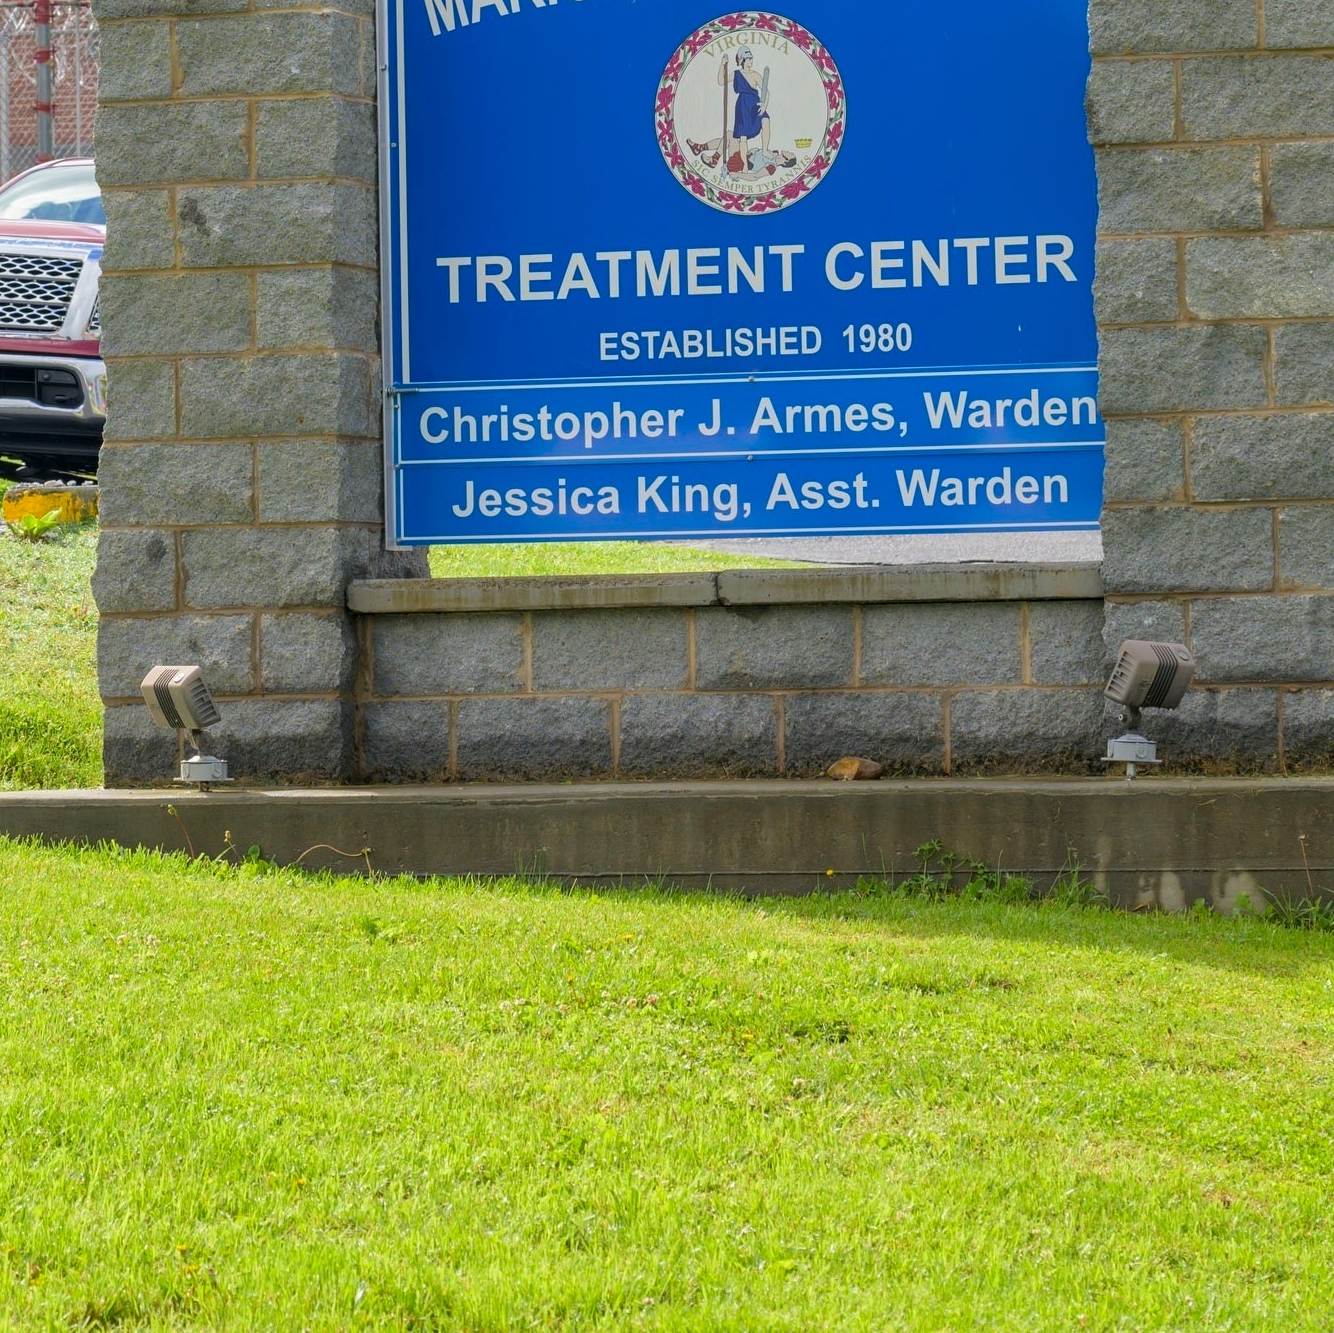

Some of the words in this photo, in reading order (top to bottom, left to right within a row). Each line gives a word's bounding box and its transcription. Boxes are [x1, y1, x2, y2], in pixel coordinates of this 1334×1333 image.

[703, 31, 790, 58] VIRGINIA
[691, 159, 710, 178] SIC
[710, 170, 755, 194] SEMPER
[756, 154, 812, 194] TYRANNIS
[436, 244, 805, 303] TREATMENT
[825, 234, 1078, 291] CENTER
[599, 325, 822, 361] ESTABLISHED
[842, 322, 912, 353] 1980
[420, 401, 685, 449] Christopher
[698, 398, 735, 437] J.
[749, 397, 908, 438] Armes,
[923, 388, 1097, 429] Warden
[452, 478, 620, 518] Jessica
[637, 475, 751, 522] King,
[765, 472, 880, 510] Asst.
[895, 466, 1068, 507] Warden
